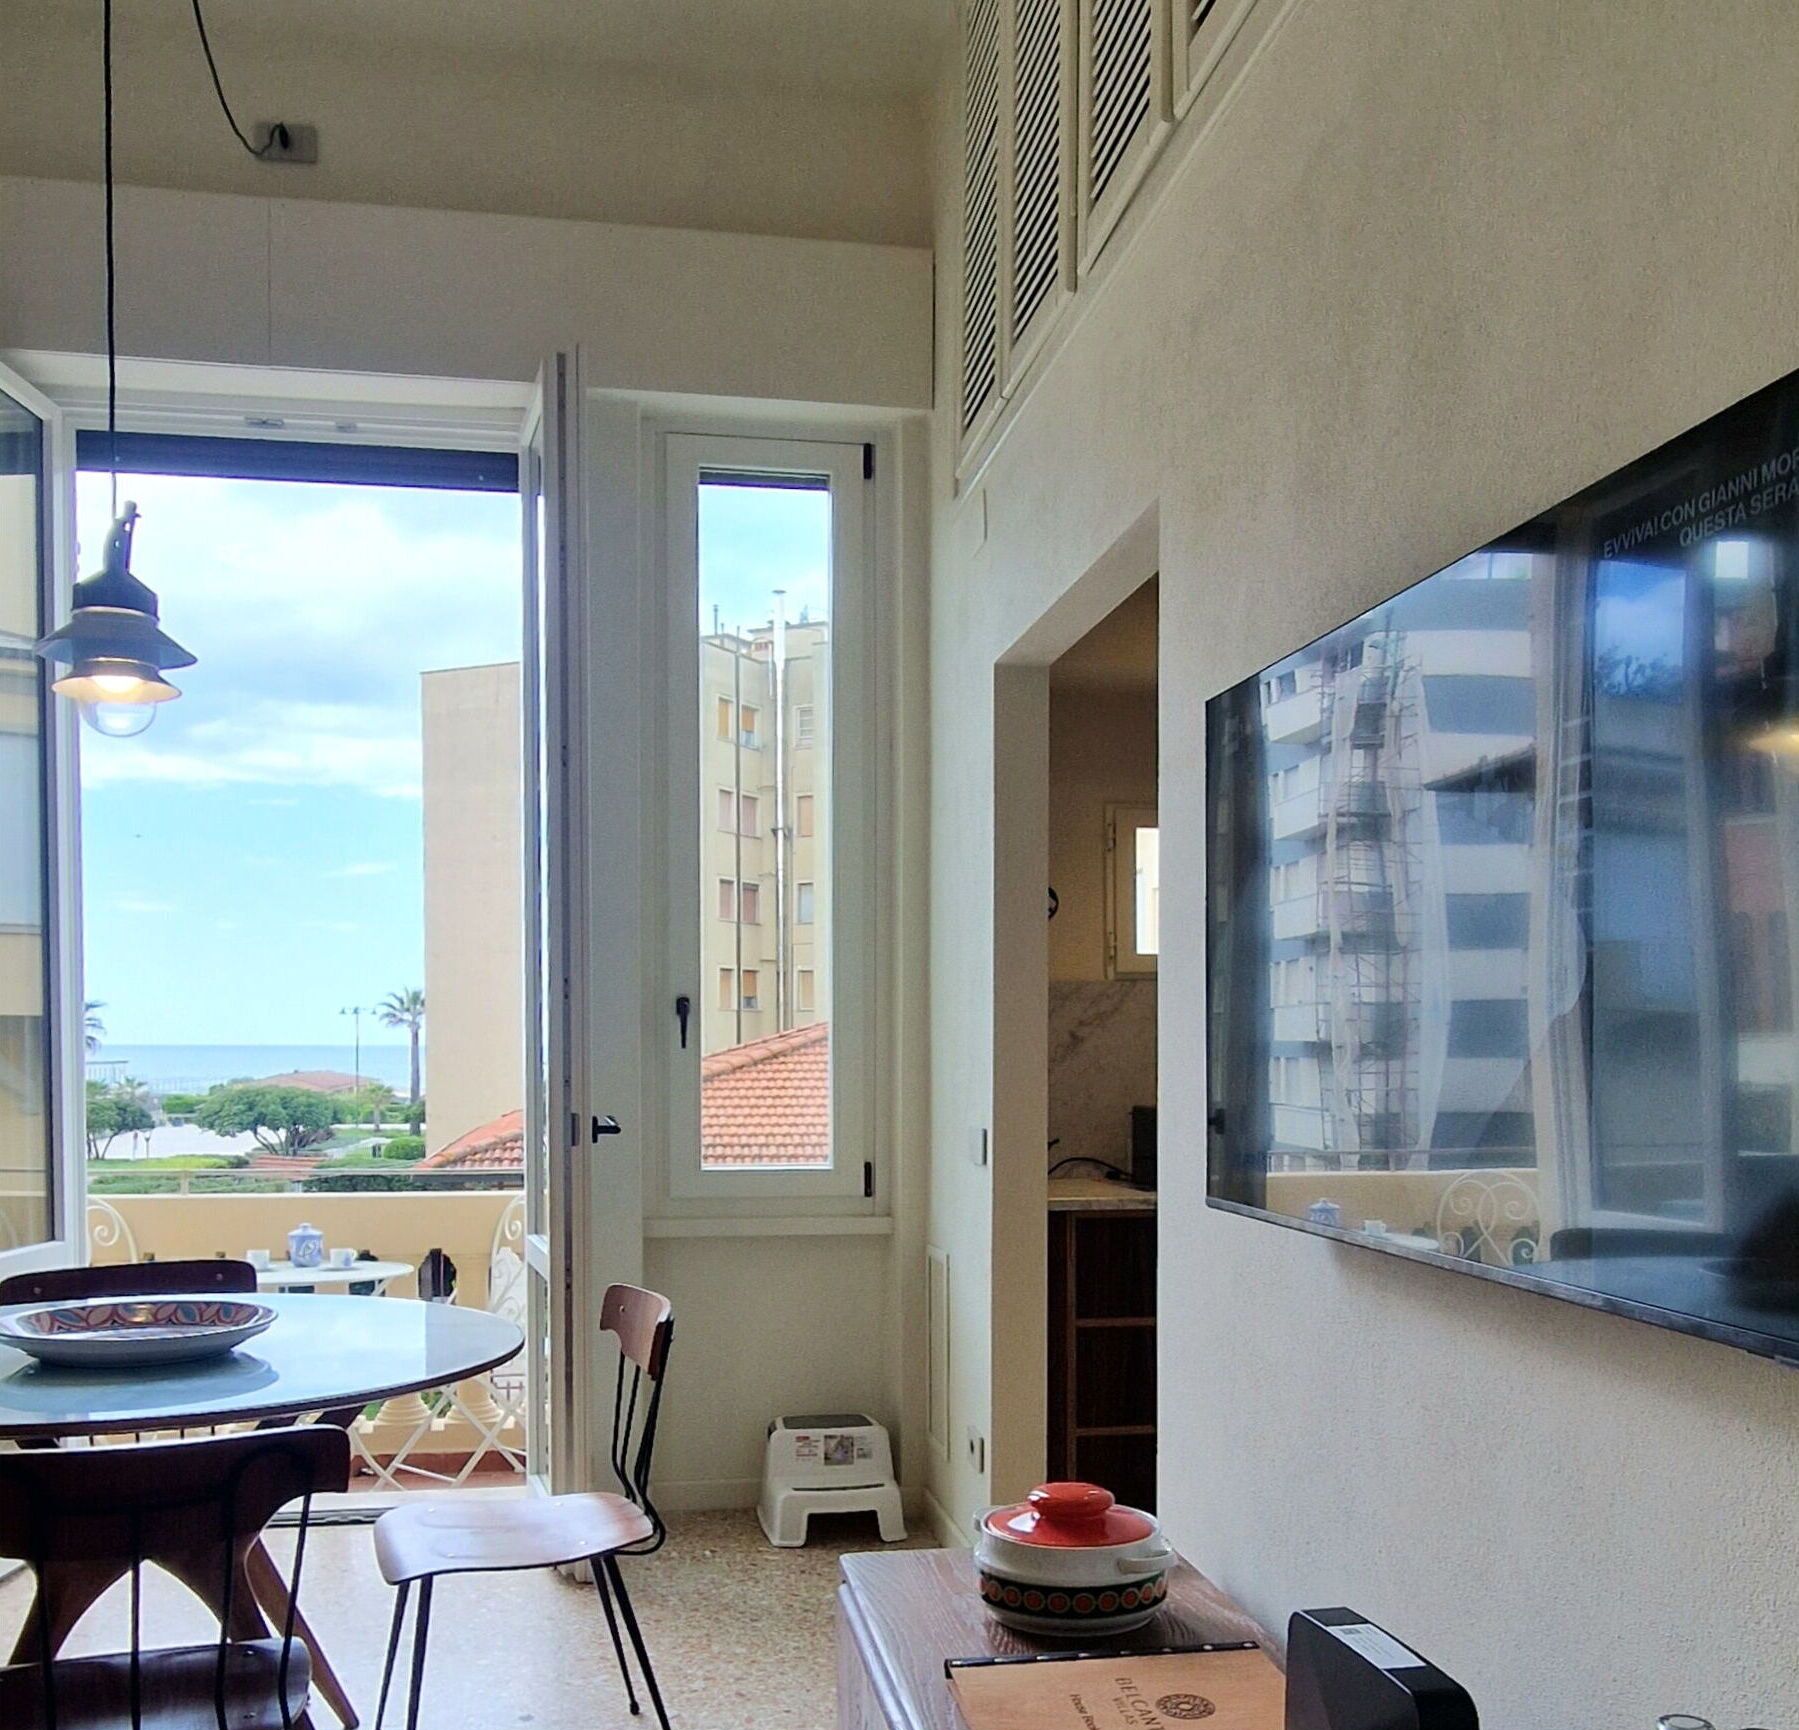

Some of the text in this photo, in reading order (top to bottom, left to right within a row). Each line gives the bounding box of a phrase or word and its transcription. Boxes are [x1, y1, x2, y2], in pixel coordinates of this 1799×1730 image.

[1660, 498, 1695, 531] CON
[1699, 468, 1758, 513] GIANNI
[1679, 477, 1799, 547] QUESTA SERA
